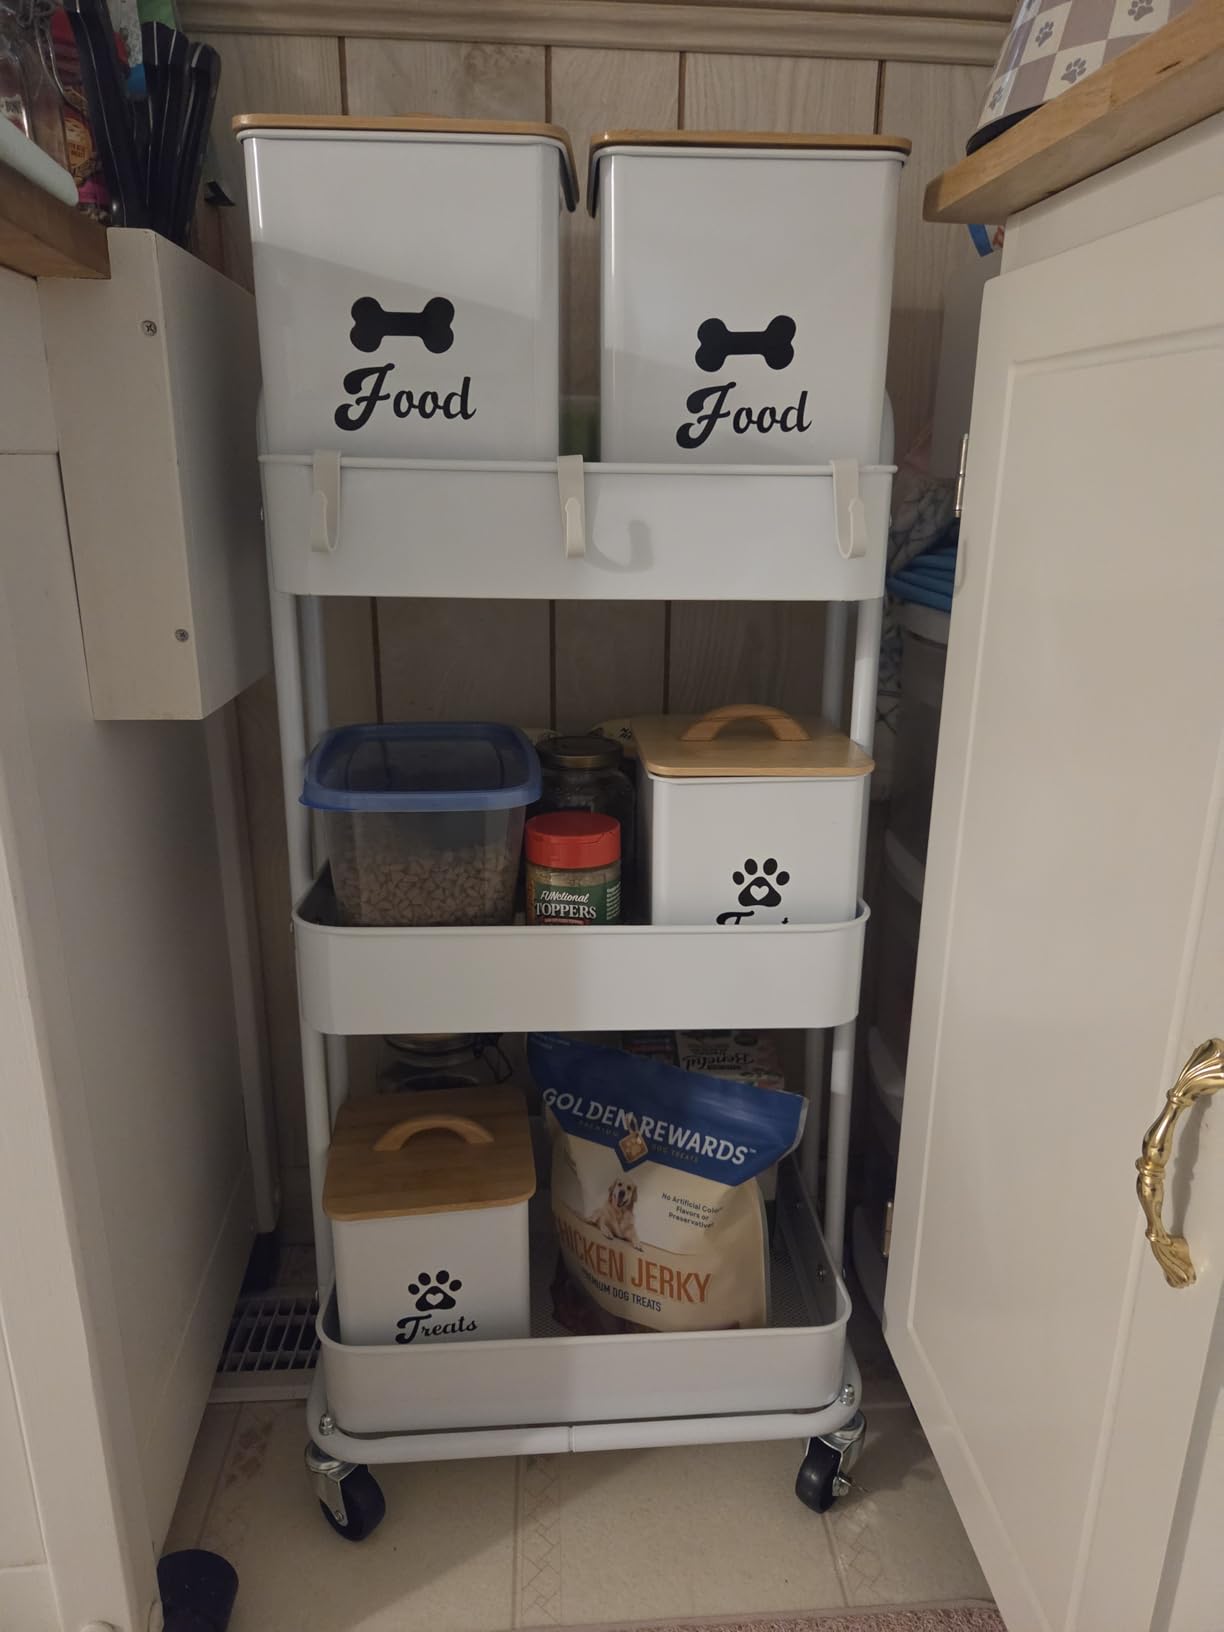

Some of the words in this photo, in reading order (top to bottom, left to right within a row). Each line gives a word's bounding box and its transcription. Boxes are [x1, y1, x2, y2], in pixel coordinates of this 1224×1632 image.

[334, 363, 477, 431] Food
[676, 381, 812, 449] Food
[536, 903, 597, 919] TOPPERS
[542, 1088, 632, 1131] GOLDEN
[661, 1192, 671, 1201] No
[672, 1196, 701, 1210] Artificial
[676, 1205, 700, 1218] Flavors
[558, 1216, 624, 1282] HICKEN
[631, 1257, 712, 1303] JERKY
[612, 1286, 629, 1302] DOG
[632, 1294, 662, 1313] TREATS
[395, 1313, 478, 1344] Treats
